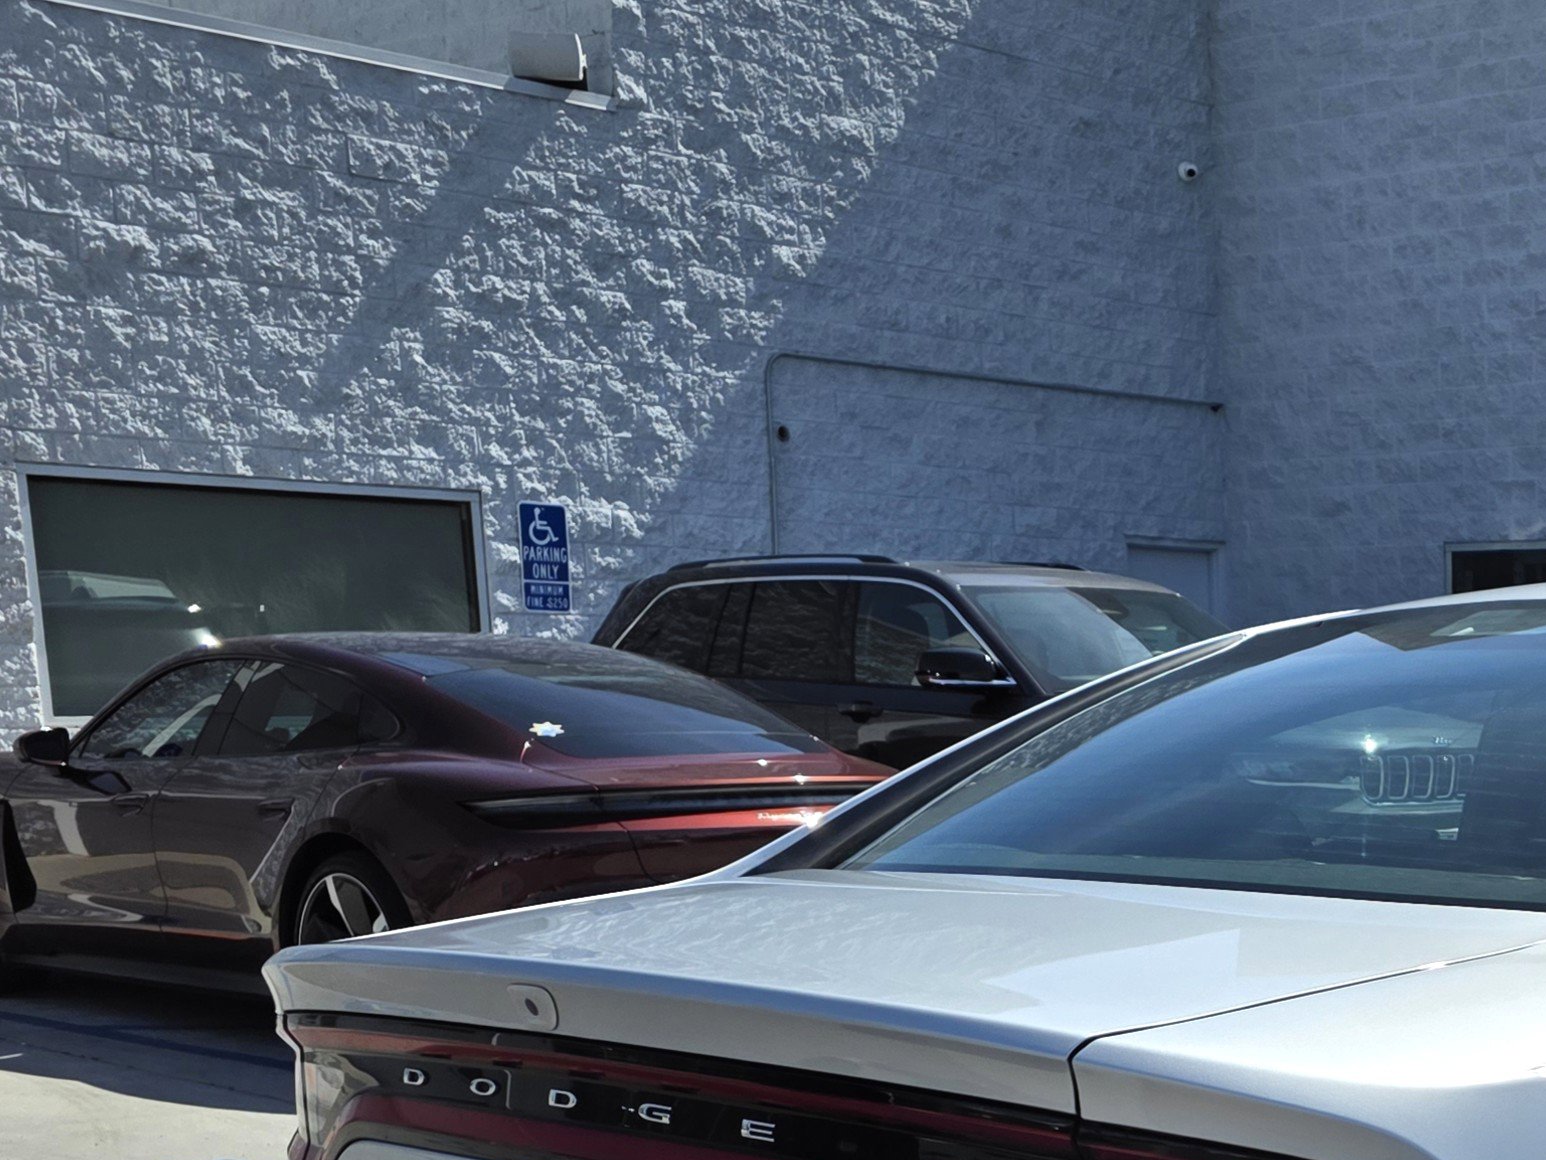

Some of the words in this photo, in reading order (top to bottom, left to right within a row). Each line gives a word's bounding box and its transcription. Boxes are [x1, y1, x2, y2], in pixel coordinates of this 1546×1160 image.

[523, 545, 567, 563] PARKING
[532, 562, 559, 579] ONLY
[403, 1067, 776, 1143] DODGE
